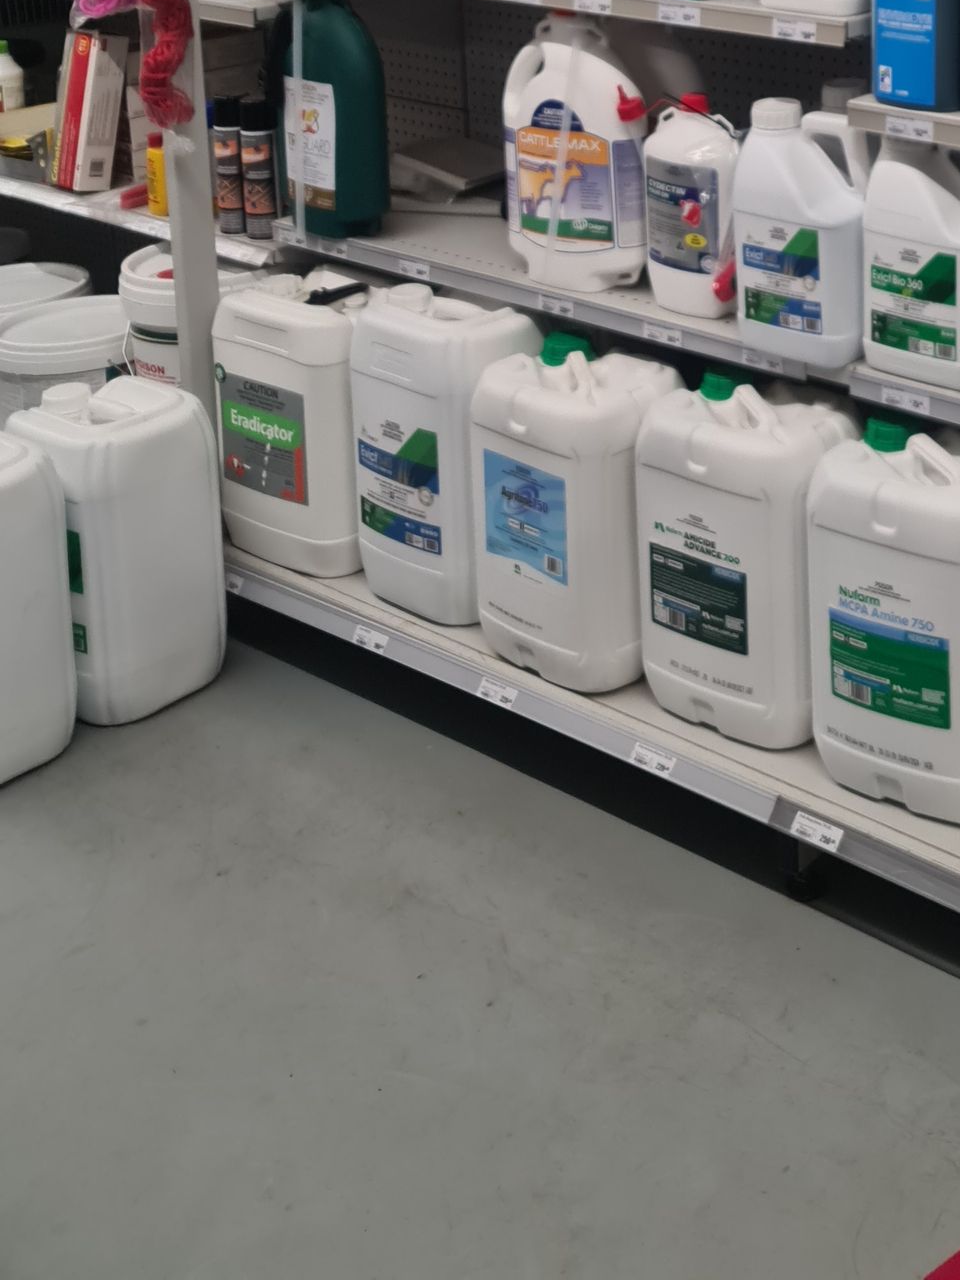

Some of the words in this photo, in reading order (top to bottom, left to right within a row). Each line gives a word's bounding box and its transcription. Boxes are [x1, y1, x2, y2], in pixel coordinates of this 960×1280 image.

[906, 276, 923, 292] 360
[243, 380, 280, 400] CAUTION
[229, 407, 296, 444] Eradicator
[683, 531, 717, 550] AMICIDE
[683, 540, 723, 561] ADVANCE
[838, 583, 881, 608] Nufarm
[838, 596, 869, 617] MCPA
[870, 606, 910, 627] Amine
[911, 616, 935, 633] 750
